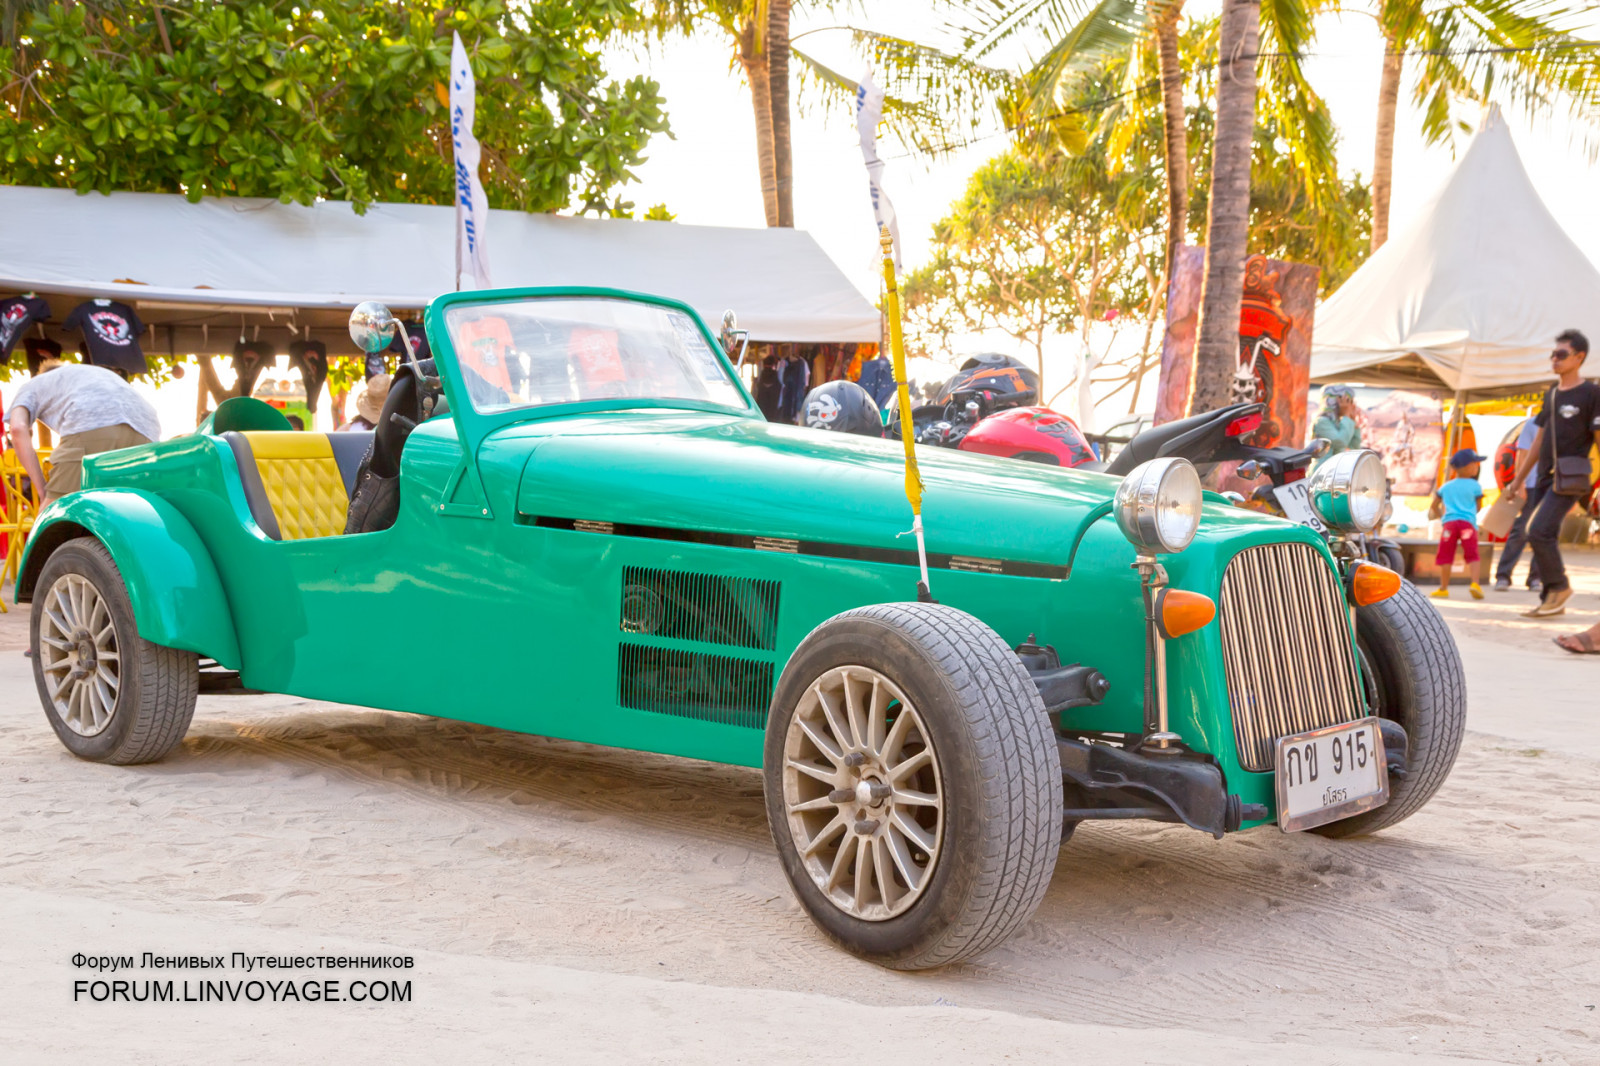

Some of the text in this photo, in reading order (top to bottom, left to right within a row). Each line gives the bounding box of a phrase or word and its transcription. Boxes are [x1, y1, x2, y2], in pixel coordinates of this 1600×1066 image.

[1287, 730, 1367, 787] กข 915
[1322, 786, 1347, 806] ยโสธร
